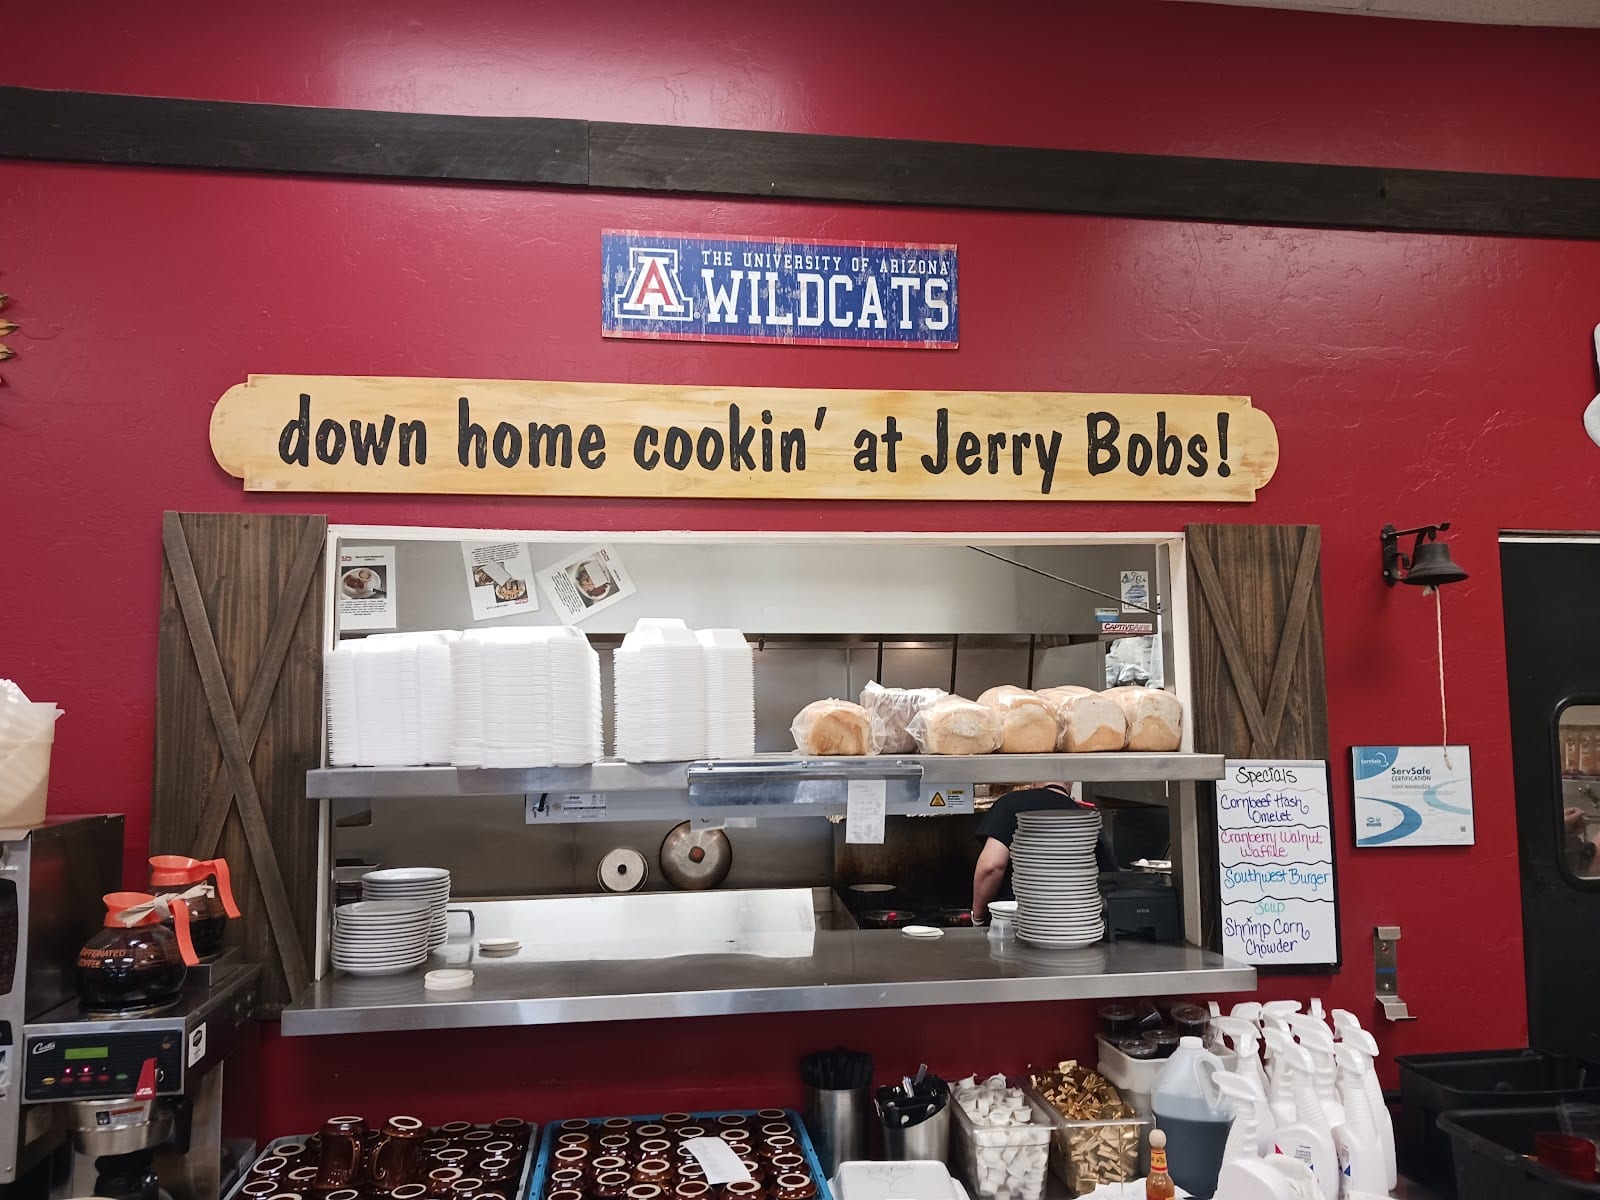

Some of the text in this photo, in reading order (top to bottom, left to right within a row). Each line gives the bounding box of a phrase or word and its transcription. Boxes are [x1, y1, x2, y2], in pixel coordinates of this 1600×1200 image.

[702, 250, 950, 276] THE UNIVERSITY OF ARIZONA
[614, 247, 693, 321] A
[701, 268, 950, 331] WILDCATS
[278, 393, 427, 468] down
[457, 397, 607, 470] home
[854, 415, 903, 474] at
[921, 408, 1063, 494] Jerry
[1086, 410, 1231, 478] Bobs!
[1235, 766, 1298, 787] Specials
[1391, 766, 1431, 776] ServSafe
[1274, 793, 1310, 815] Hash
[1252, 810, 1294, 824] Omelet
[1220, 830, 1323, 851] Cranberry Walnut
[1223, 868, 1330, 892] Southwest Burger
[1224, 917, 1310, 942] Shrimp Corn
[1245, 938, 1298, 958] Chowder
